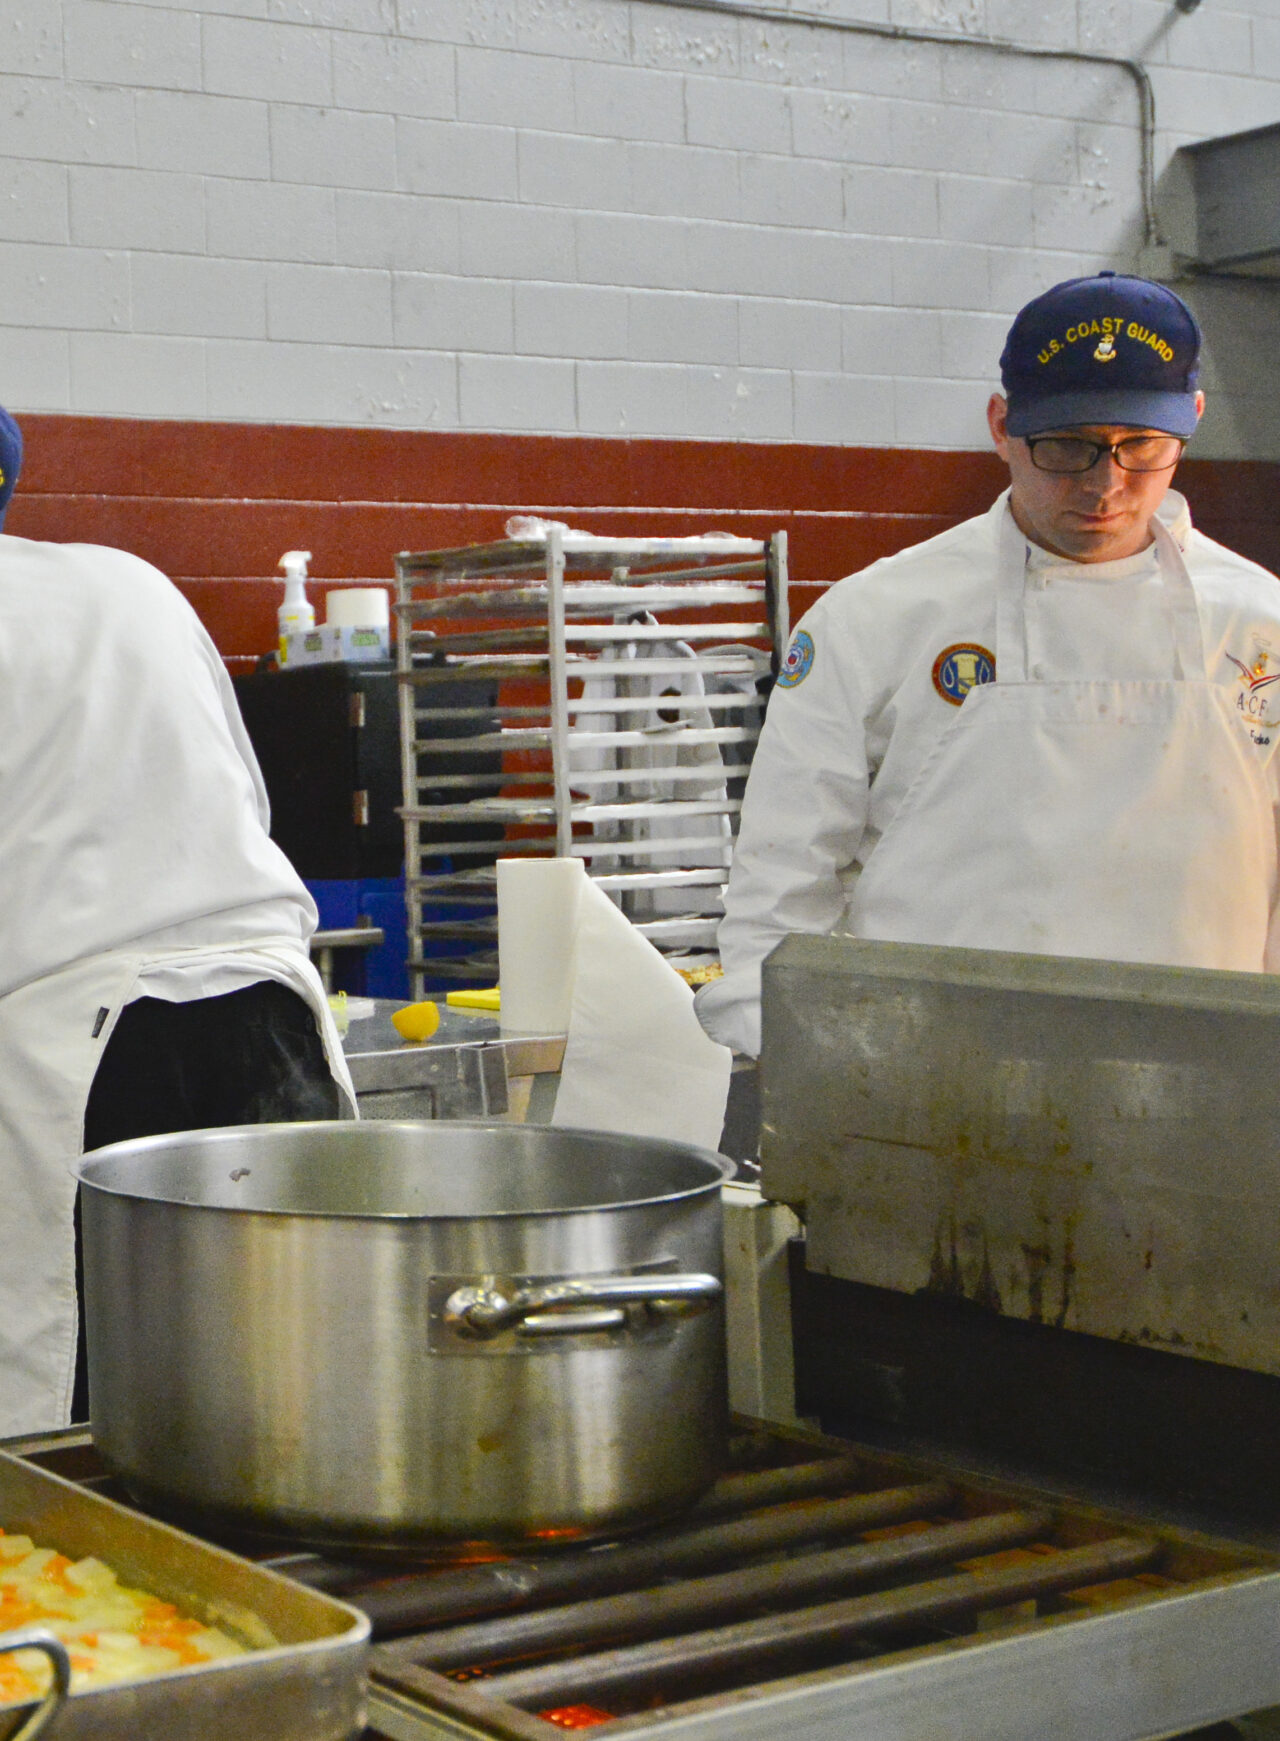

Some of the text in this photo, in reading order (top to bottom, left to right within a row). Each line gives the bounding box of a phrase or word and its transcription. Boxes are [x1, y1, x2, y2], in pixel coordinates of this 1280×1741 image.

[1037, 317, 1175, 364] U.S. COAST GUARD
